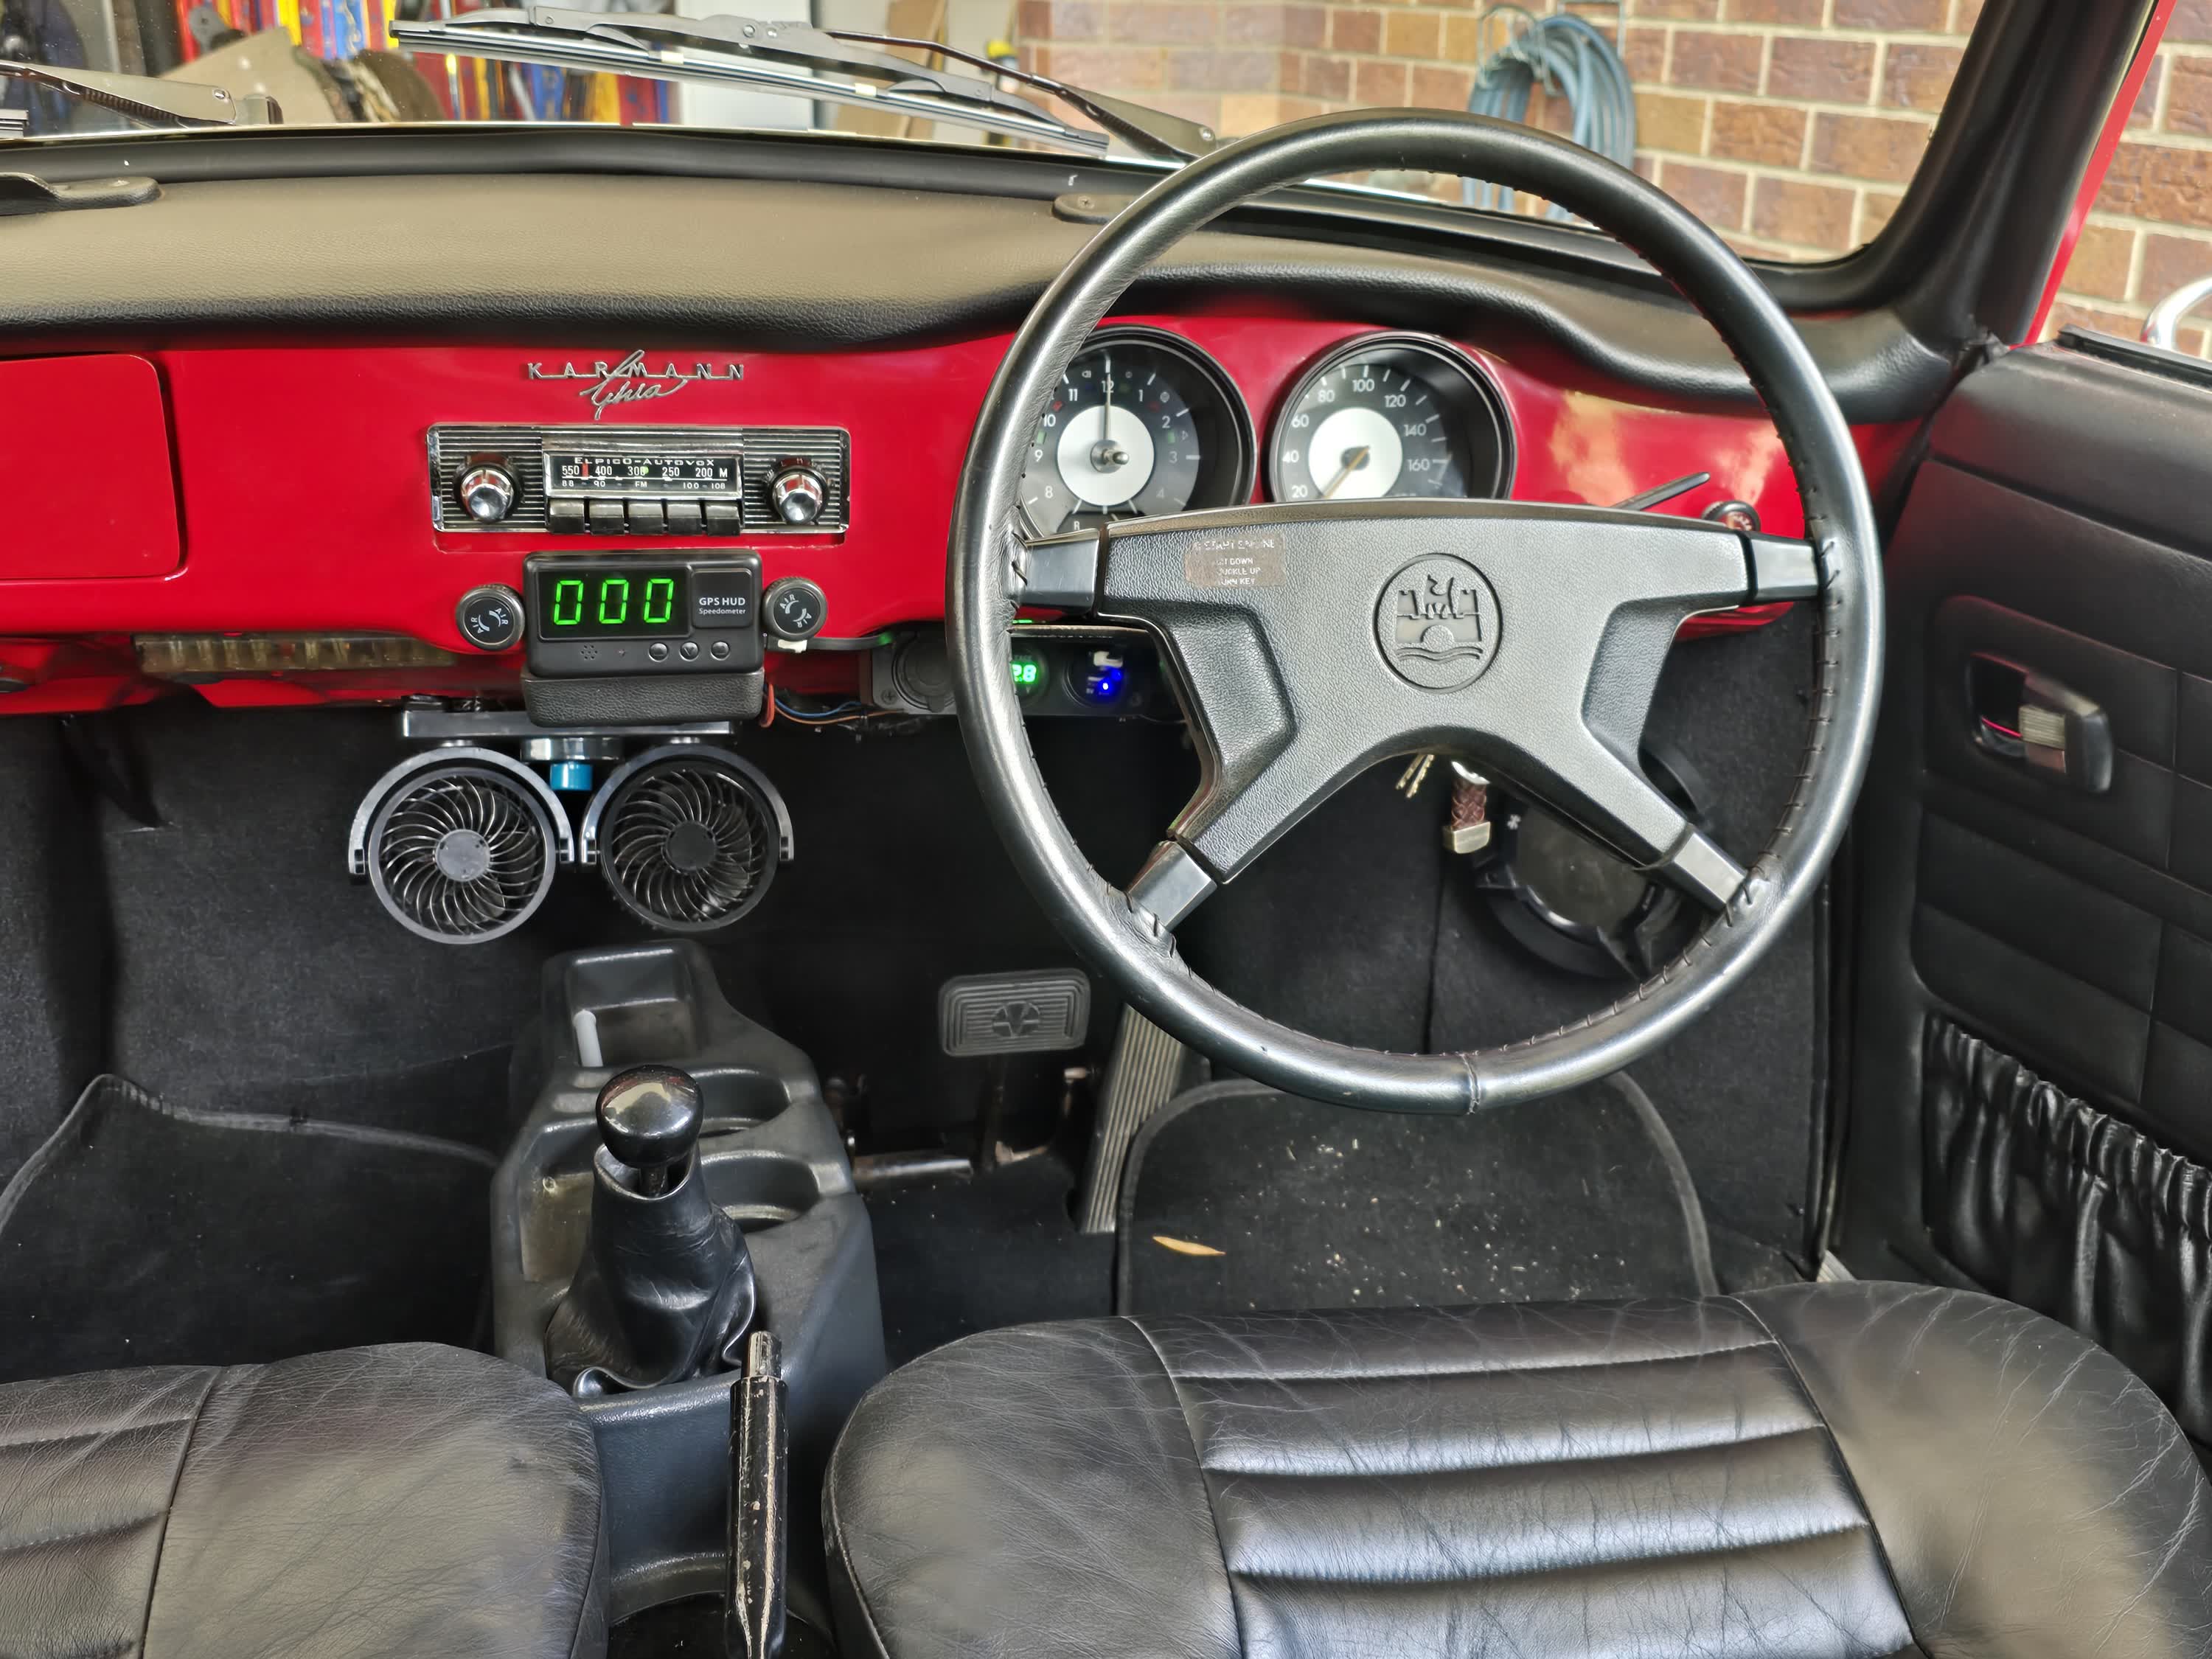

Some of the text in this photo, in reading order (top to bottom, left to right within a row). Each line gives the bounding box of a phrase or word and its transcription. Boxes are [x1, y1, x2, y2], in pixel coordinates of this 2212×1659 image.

[527, 361, 744, 380] KARMANN
[580, 349, 688, 420] Ghia
[1101, 380, 1114, 393] 12
[1352, 379, 1375, 392] 100
[1068, 389, 1078, 402] 11
[1138, 389, 1144, 402] 1
[1317, 389, 1335, 403] 80
[1384, 394, 1406, 408] 120
[1043, 414, 1057, 427] 10
[1161, 415, 1171, 428] 2
[1291, 414, 1310, 428] 60
[1404, 423, 1427, 437] 140
[1034, 449, 1043, 462] 9
[1169, 451, 1178, 464] 3
[1282, 450, 1299, 463] 40
[1407, 458, 1430, 472] 160
[562, 466, 728, 478] 550 400 300 250 200 M
[1045, 485, 1054, 498] 8
[1156, 487, 1165, 498] 4
[1292, 484, 1308, 498] 20
[699, 597, 746, 606] GPS HUD
[779, 594, 796, 609] AIR
[495, 608, 509, 625] AIR
[698, 608, 746, 616] Speedometer
[470, 616, 484, 634] AIR
[796, 613, 812, 628] AIR
